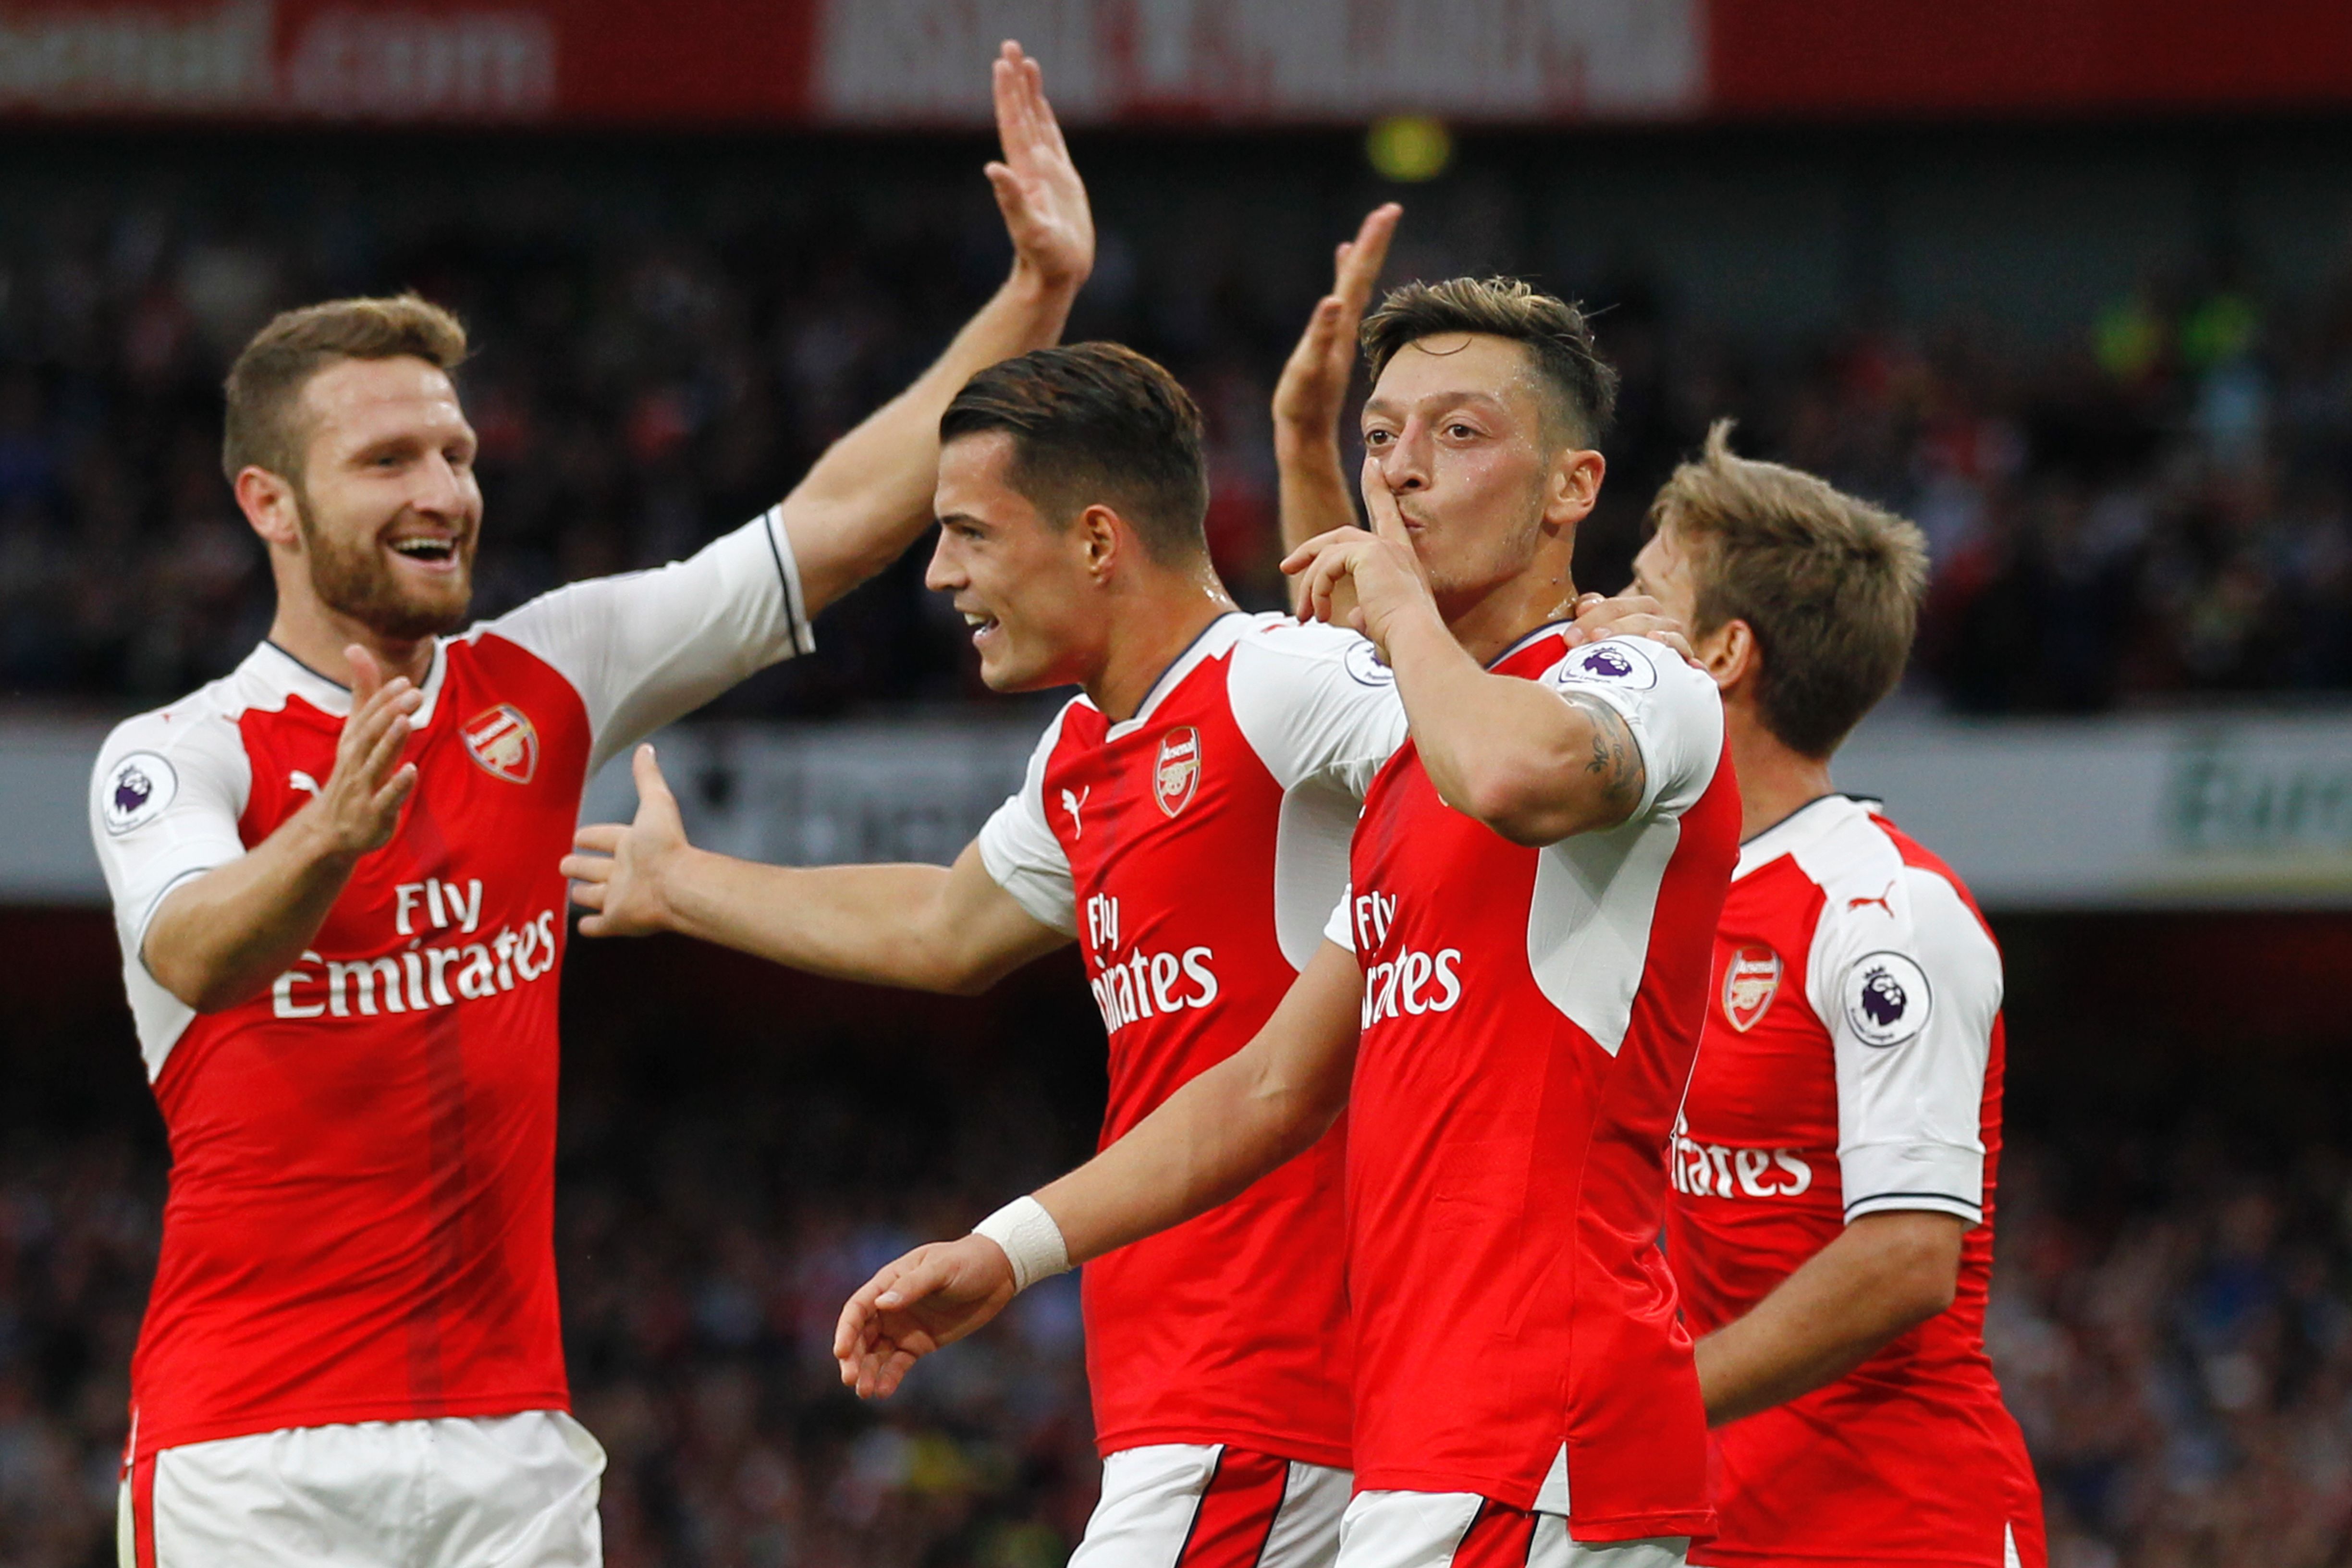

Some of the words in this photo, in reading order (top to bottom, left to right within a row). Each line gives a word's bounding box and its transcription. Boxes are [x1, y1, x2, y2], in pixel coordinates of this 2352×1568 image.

[395, 878, 482, 935] Fly
[1088, 892, 1119, 951] Fly
[1356, 891, 1396, 950] Fly
[273, 910, 554, 1018] Emirates
